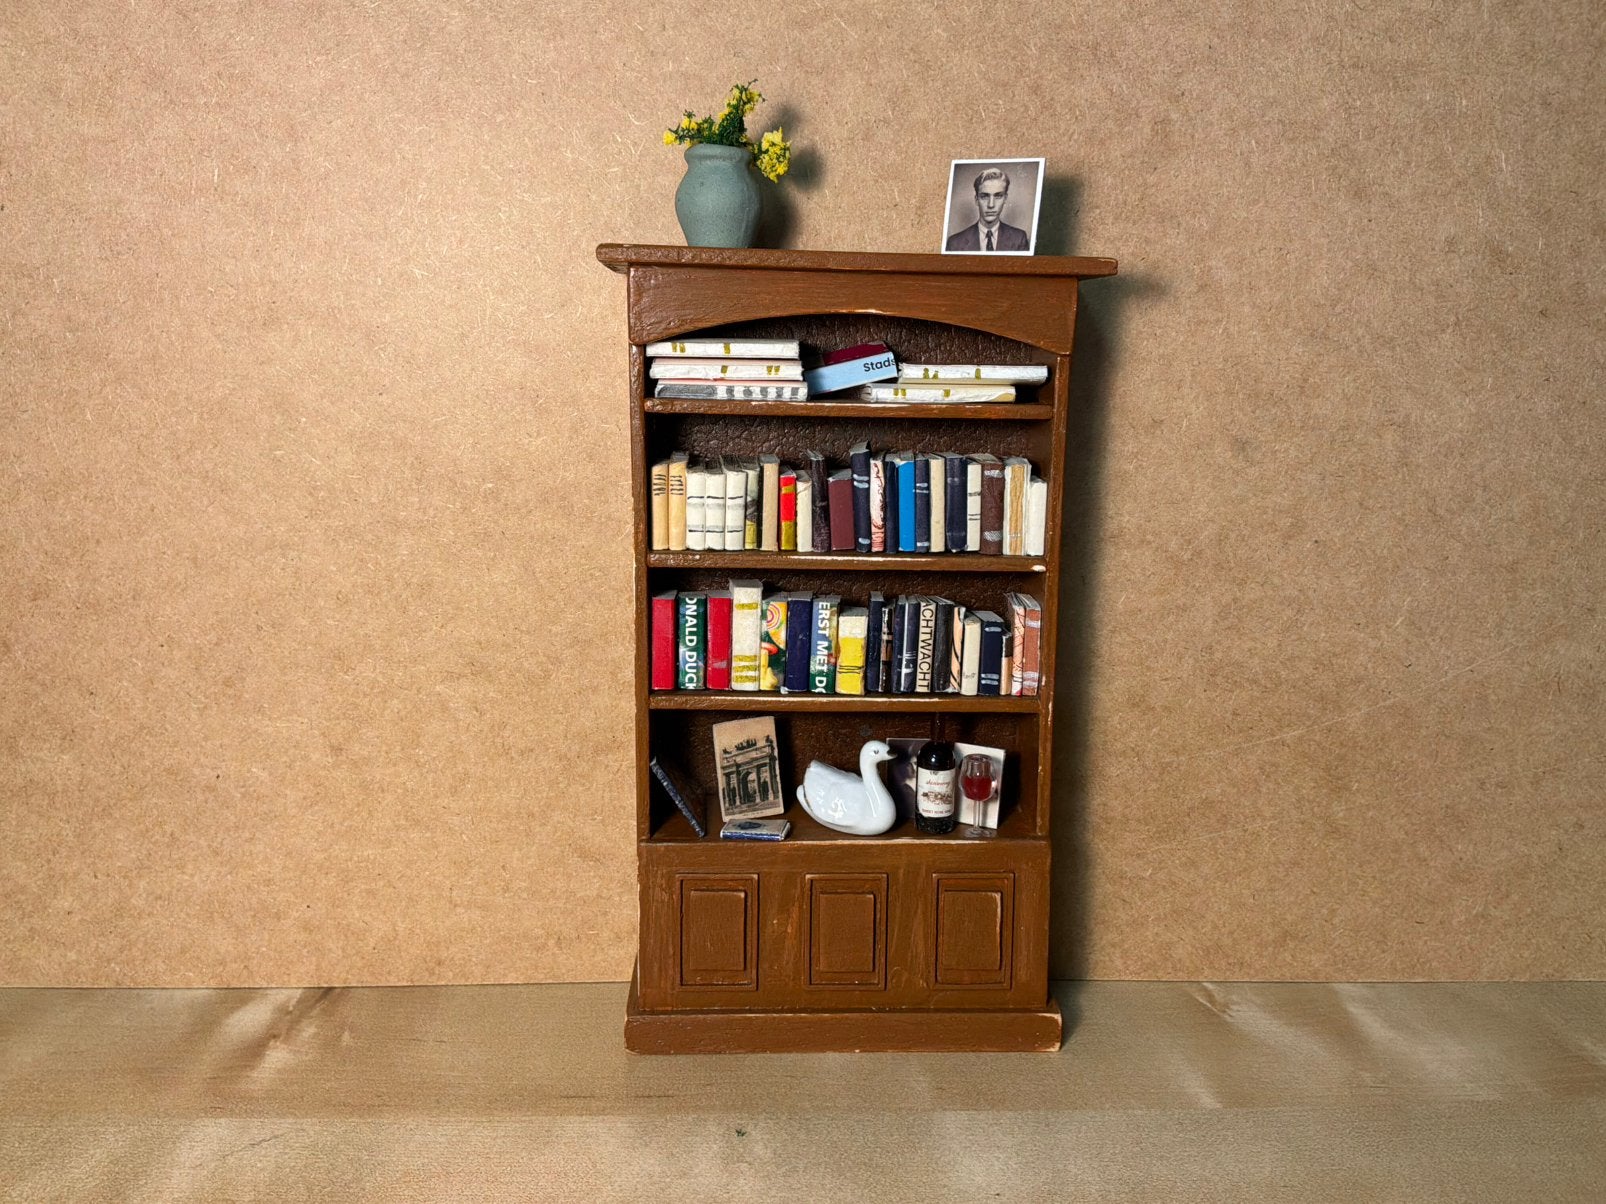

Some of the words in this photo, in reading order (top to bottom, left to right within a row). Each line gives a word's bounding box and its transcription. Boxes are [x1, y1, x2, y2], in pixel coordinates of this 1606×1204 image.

[863, 357, 896, 372] Stads
[818, 602, 831, 638] ERST
[816, 641, 829, 672] MET
